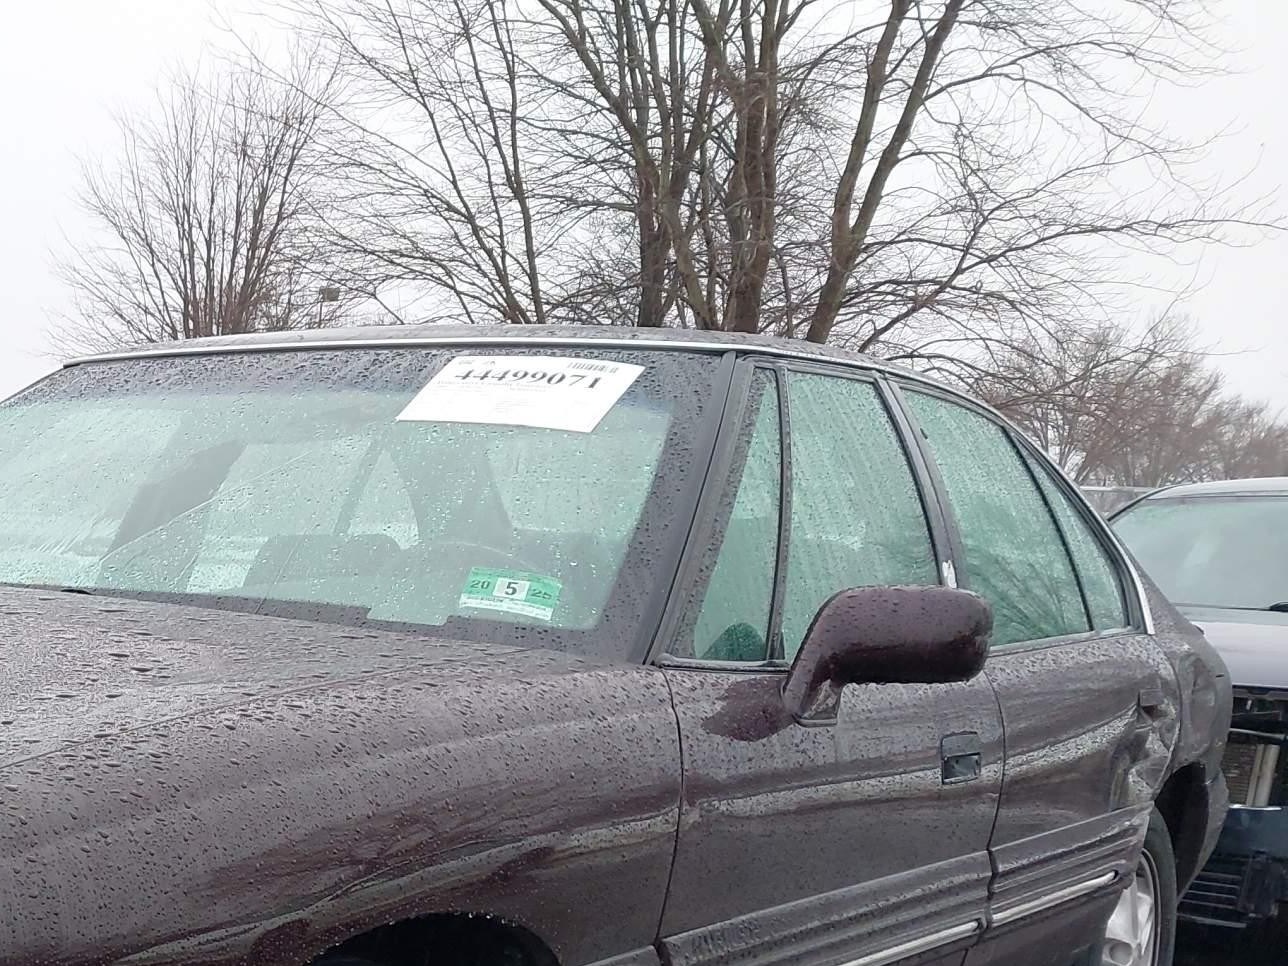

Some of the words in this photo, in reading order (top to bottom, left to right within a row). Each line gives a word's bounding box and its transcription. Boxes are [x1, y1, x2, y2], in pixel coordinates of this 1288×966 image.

[455, 368, 602, 389] 44499071
[470, 579, 491, 590] 20
[504, 581, 520, 596] 5
[530, 588, 553, 600] 25
